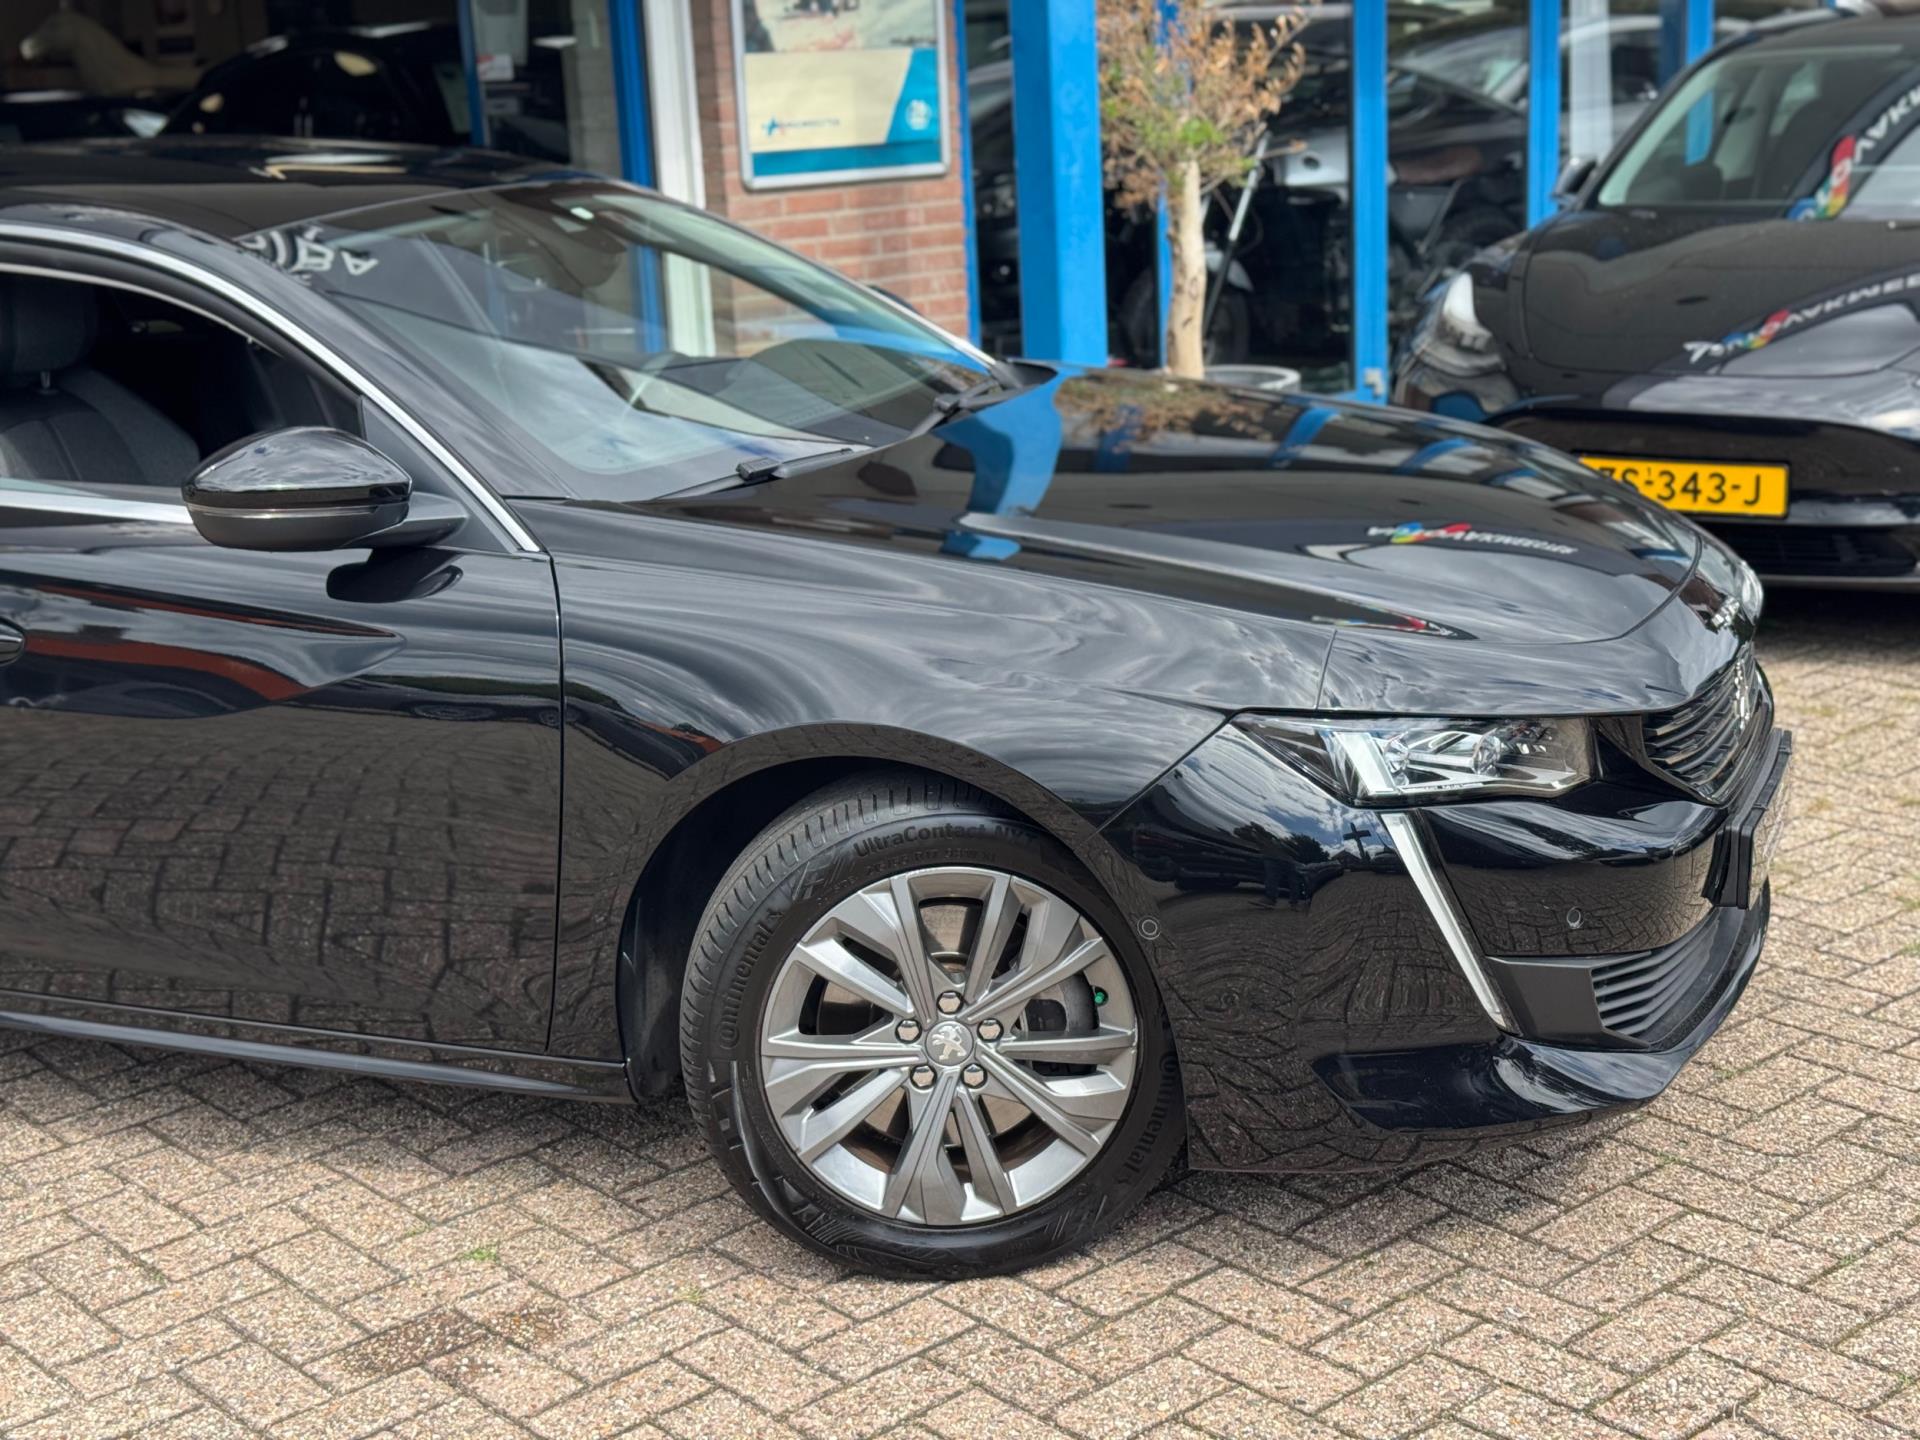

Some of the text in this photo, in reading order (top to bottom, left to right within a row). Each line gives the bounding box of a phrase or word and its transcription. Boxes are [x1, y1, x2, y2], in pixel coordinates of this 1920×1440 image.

[852, 824, 986, 858] UltraContact
[719, 922, 775, 1050] Continental
[1123, 1051, 1179, 1174] Continental
